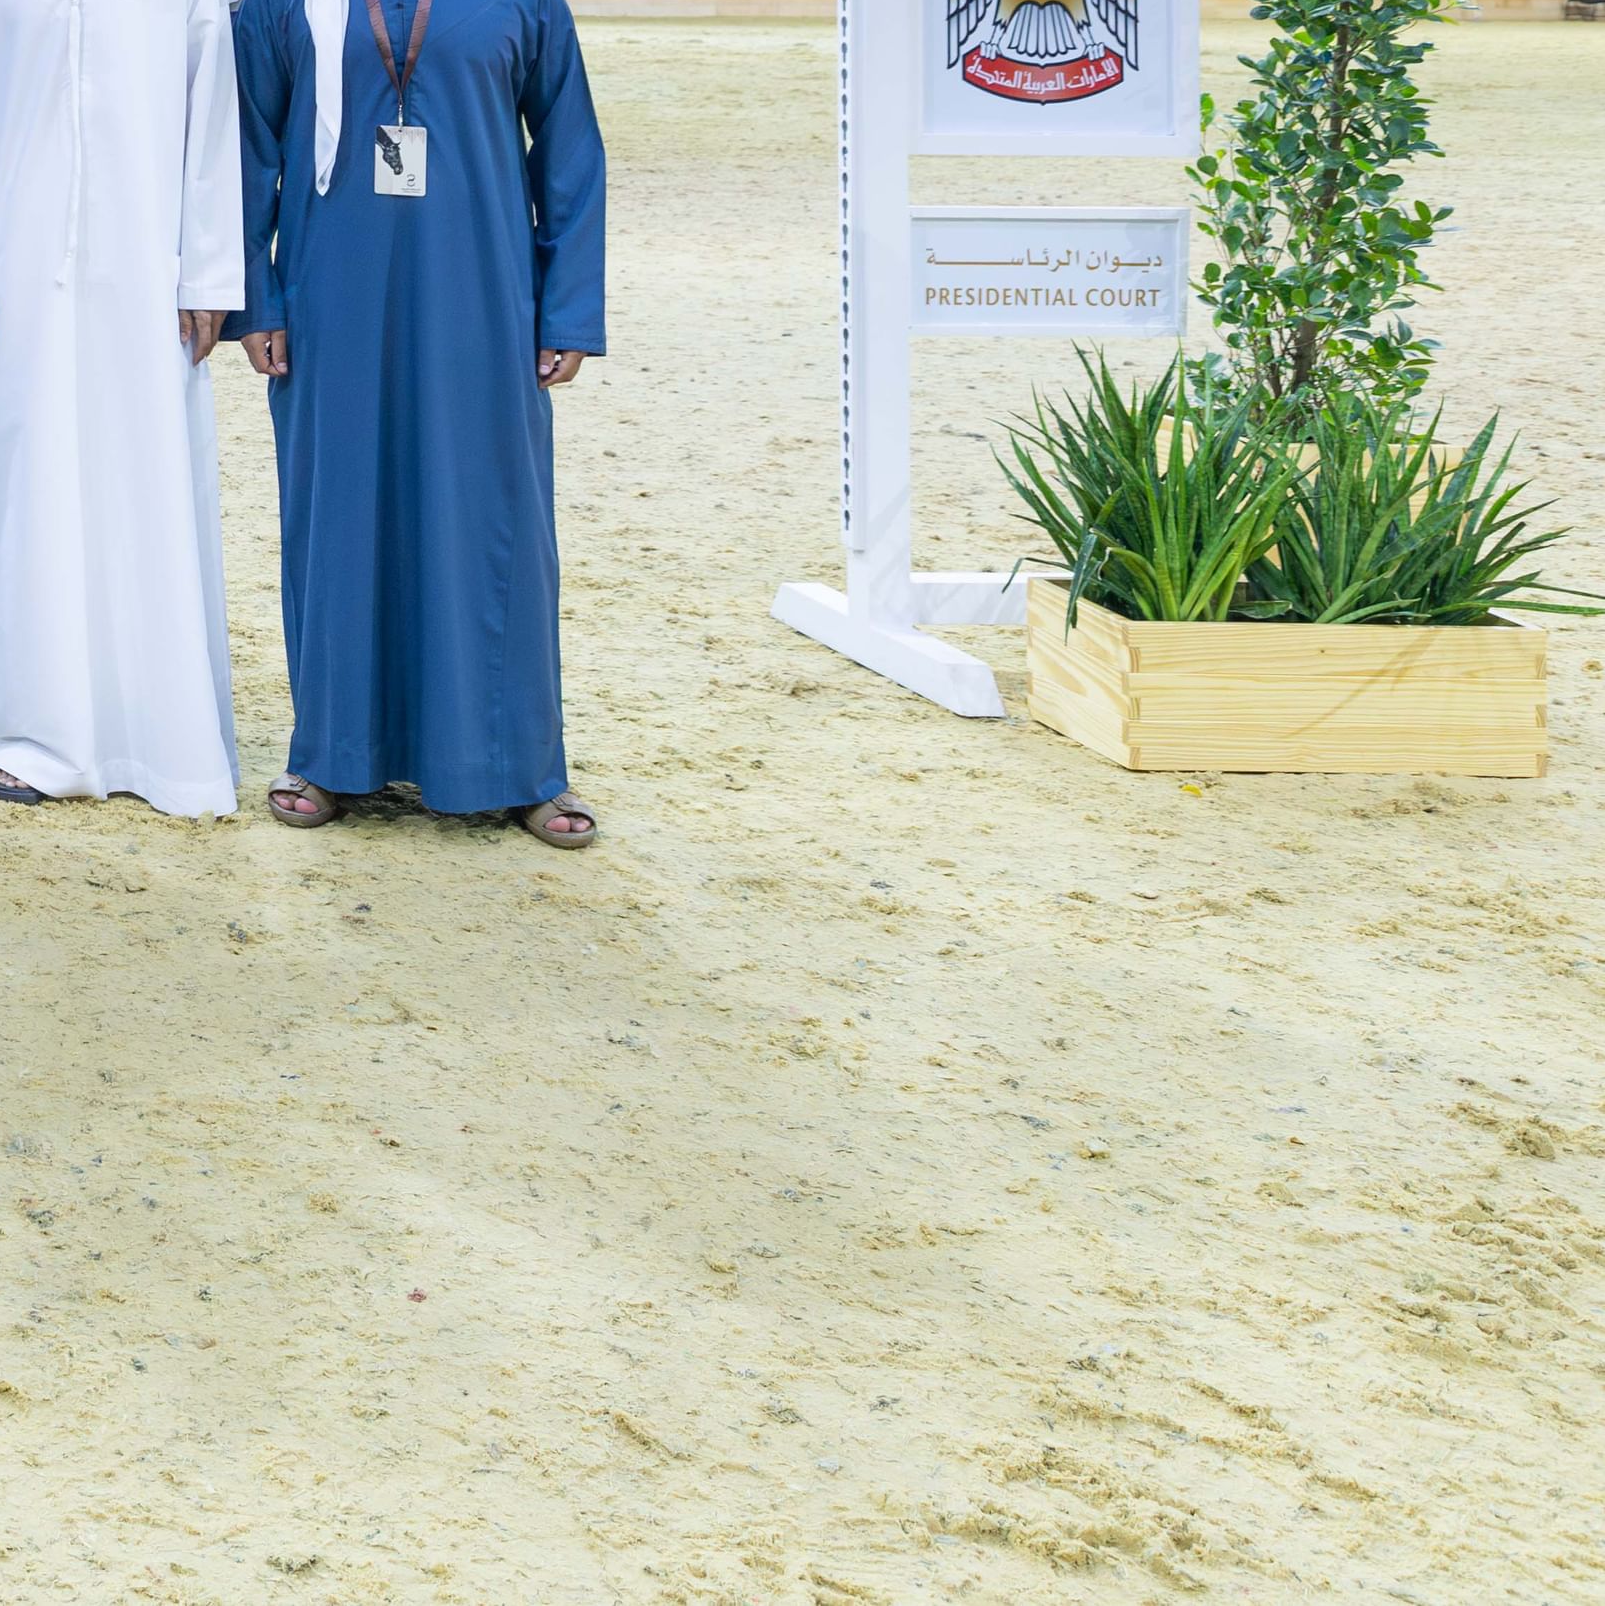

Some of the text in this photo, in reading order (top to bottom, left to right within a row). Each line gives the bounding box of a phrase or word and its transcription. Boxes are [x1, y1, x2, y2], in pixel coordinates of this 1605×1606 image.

[925, 247, 1163, 273] ديوان الرئاسة
[925, 287, 1161, 307] PRESIDENTIAL COURT
